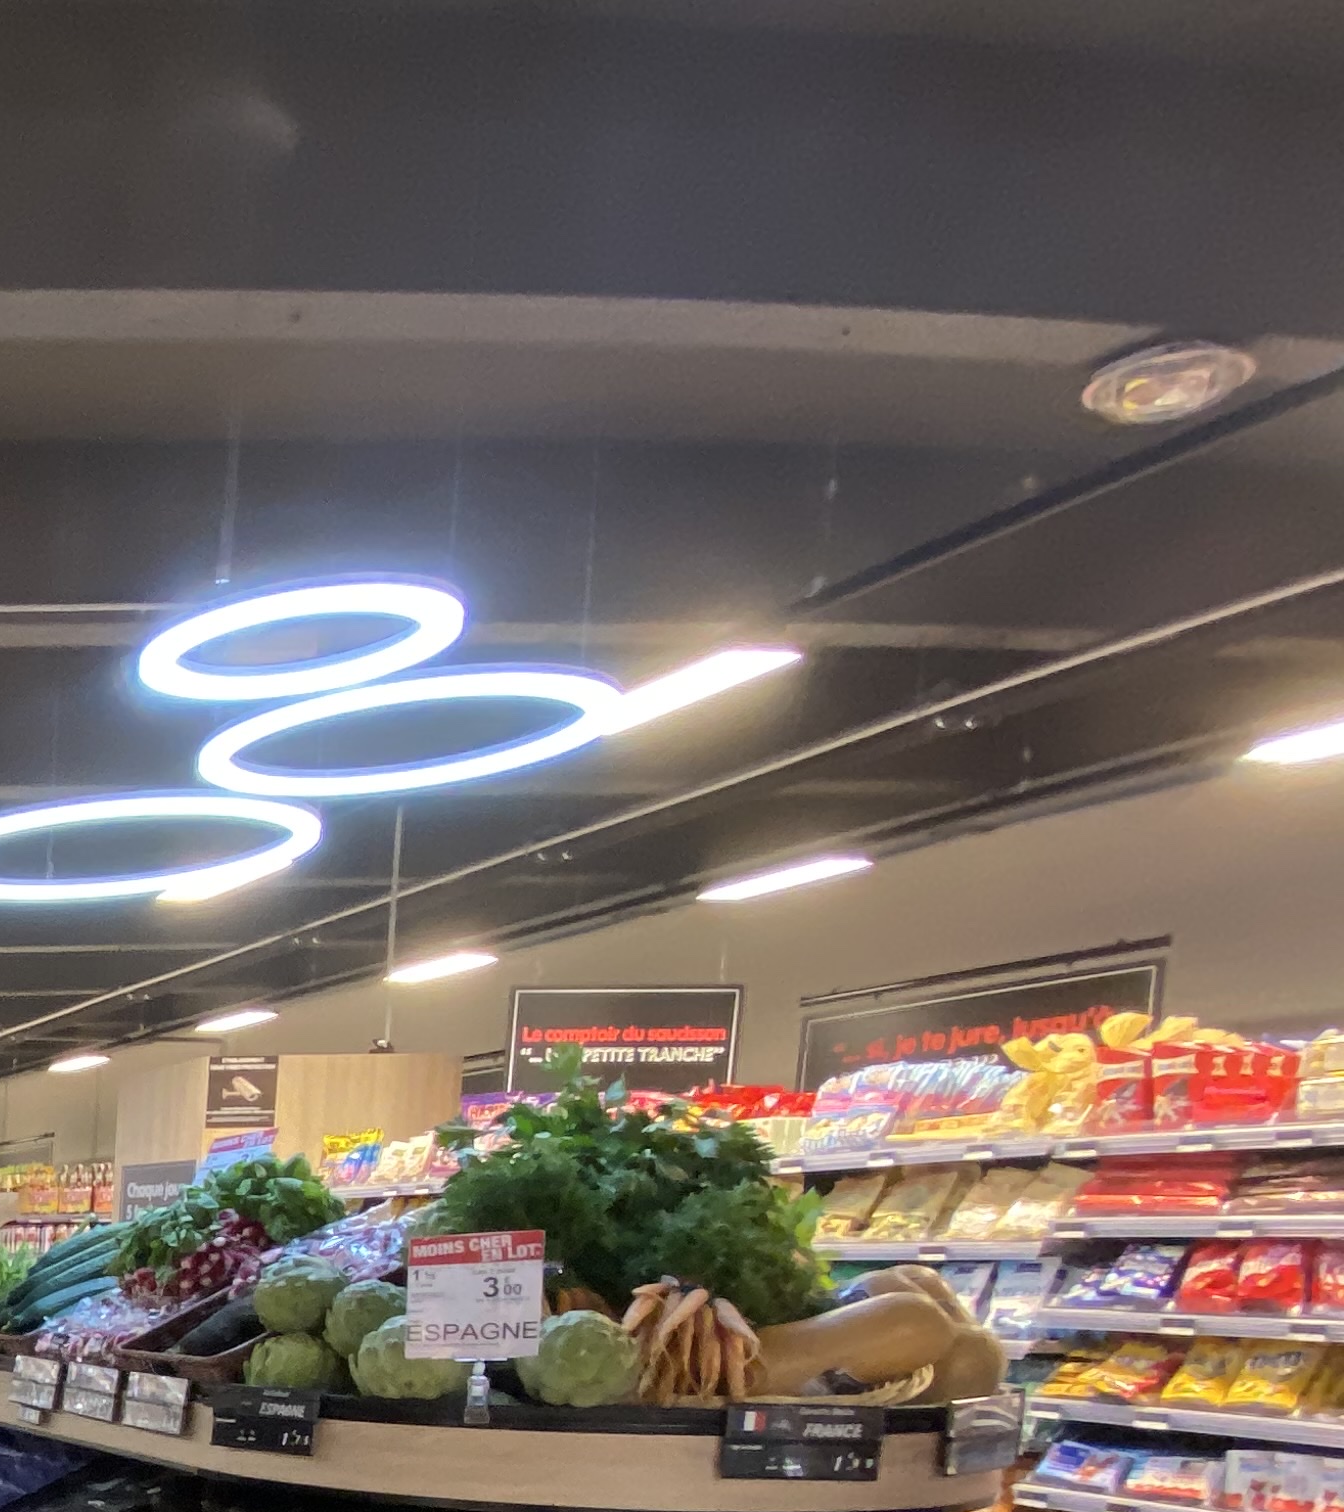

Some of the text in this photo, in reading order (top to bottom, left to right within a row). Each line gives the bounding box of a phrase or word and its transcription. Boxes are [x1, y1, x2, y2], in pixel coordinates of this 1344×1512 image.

[545, 1025, 620, 1045] comptoir
[581, 1047, 636, 1063] PETITE
[412, 1234, 512, 1258] MOINS CHER
[407, 1321, 539, 1342] ESPAGNE
